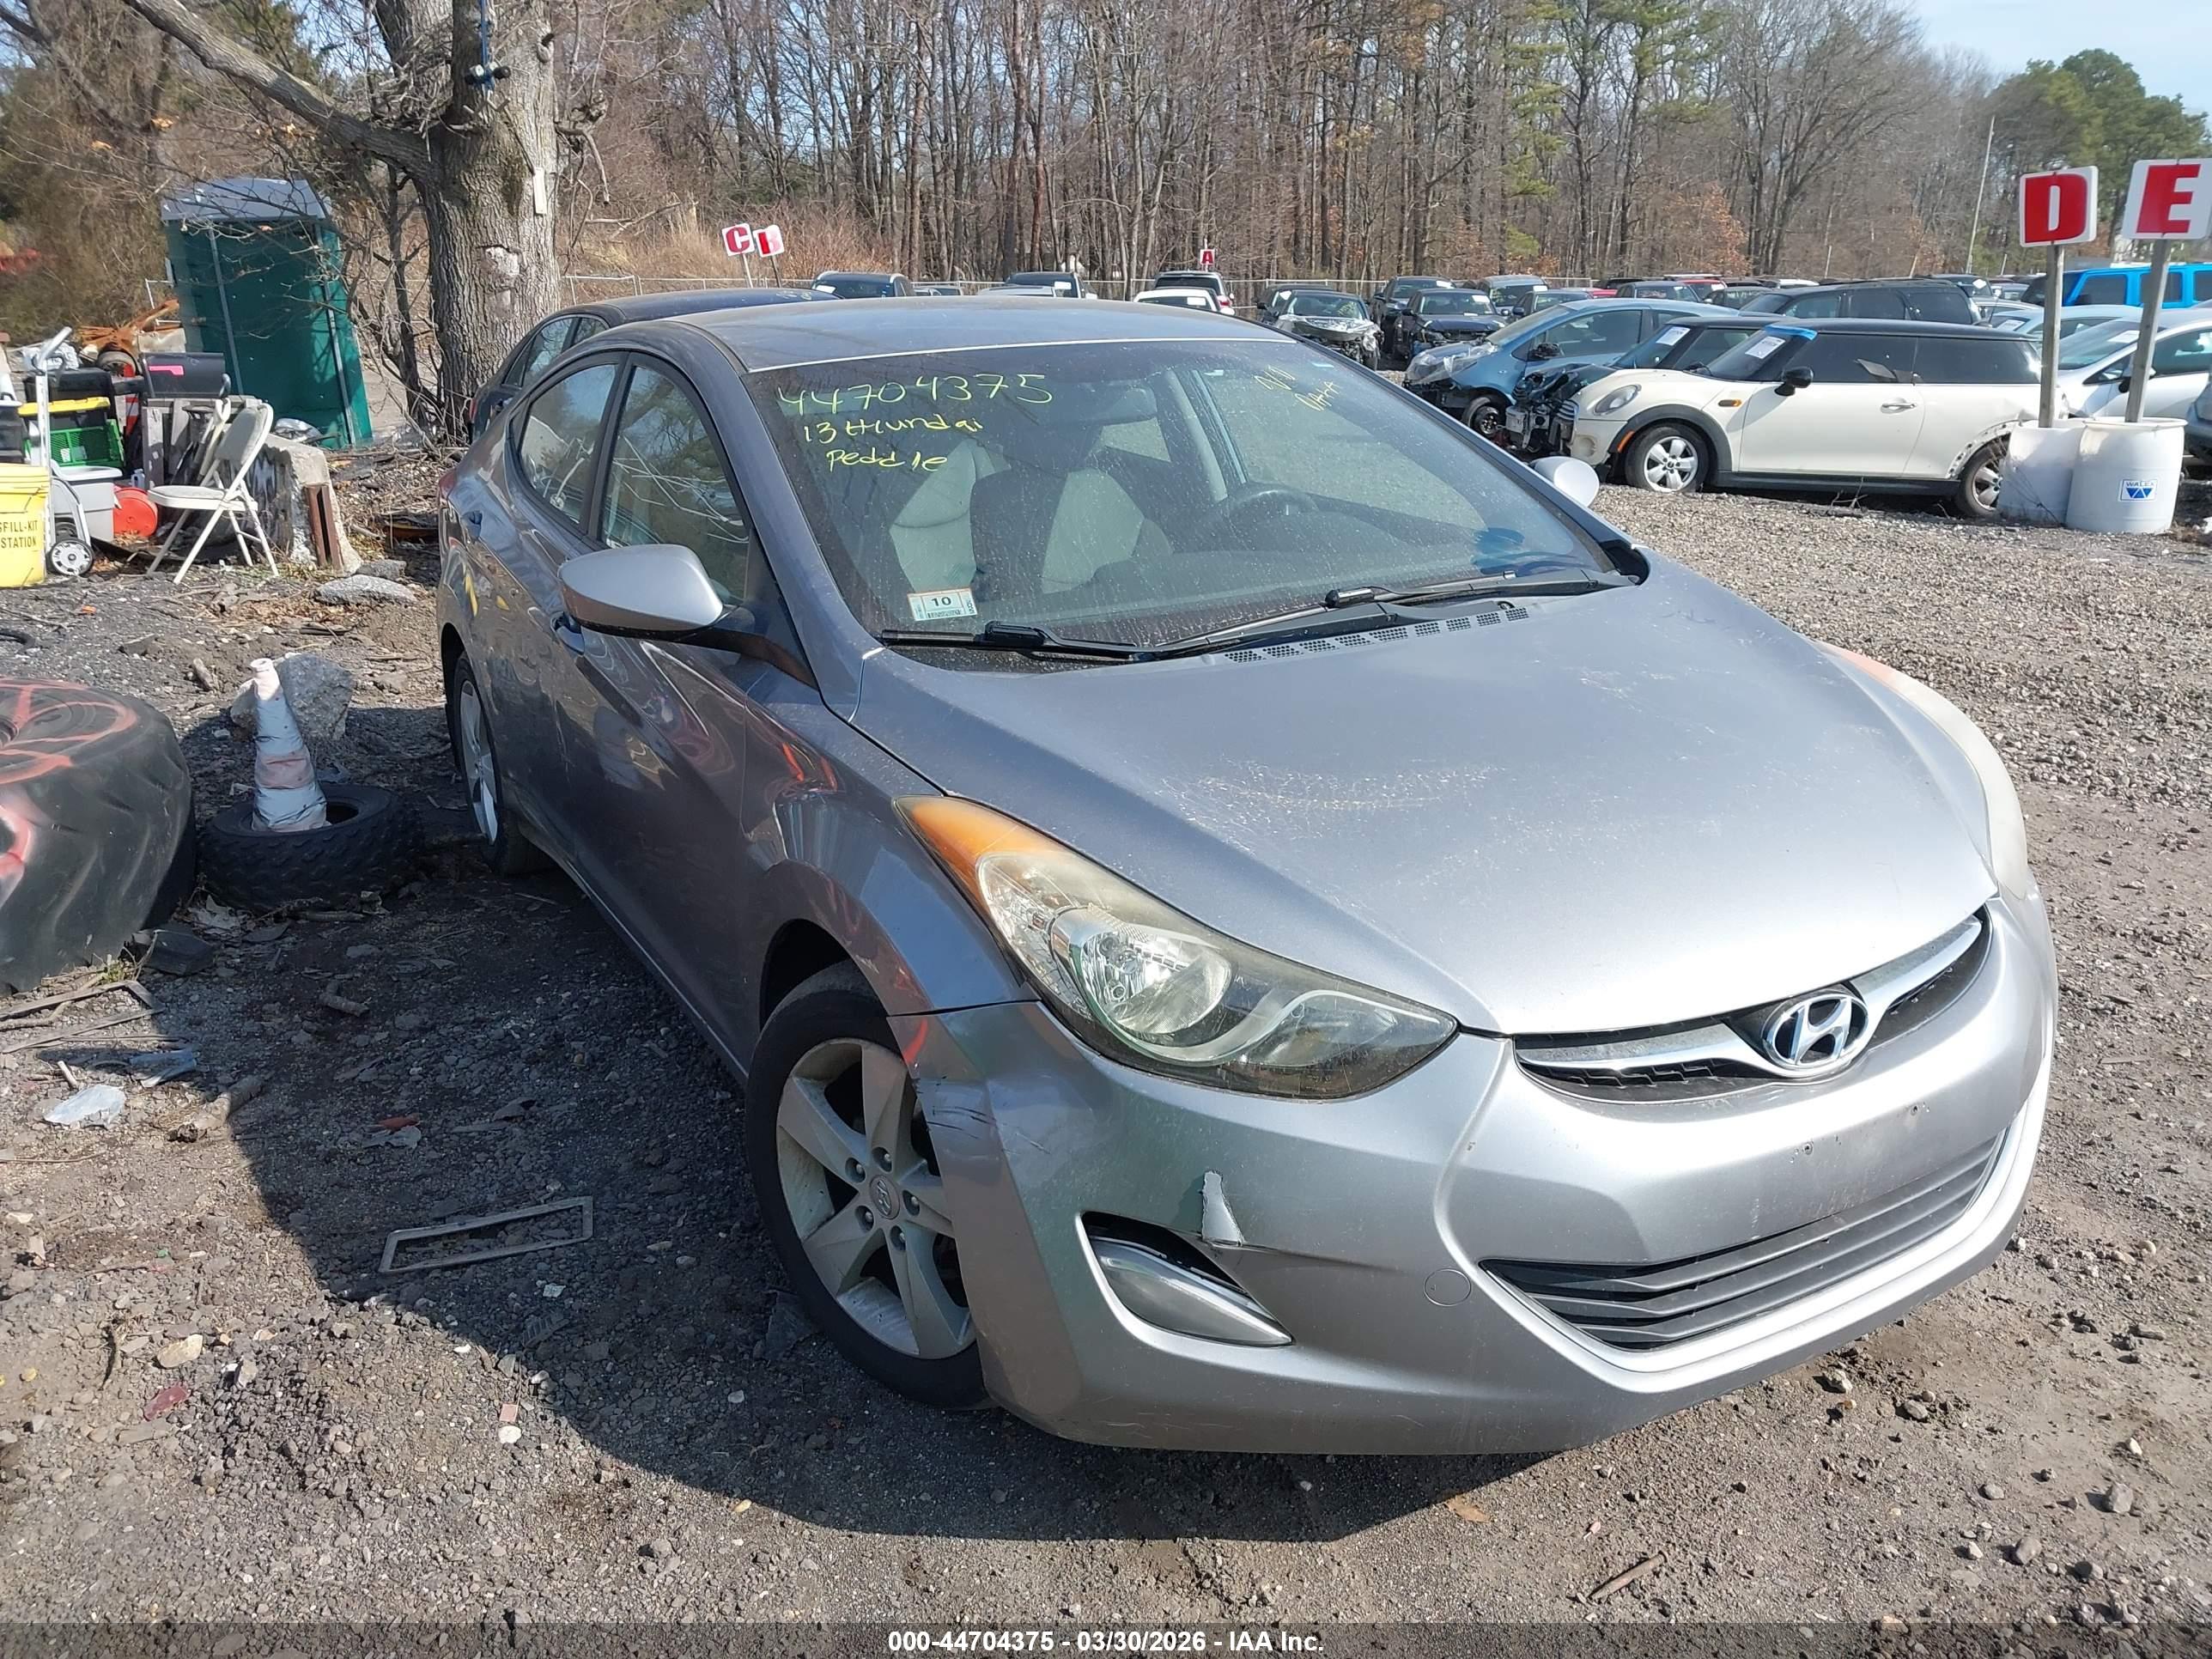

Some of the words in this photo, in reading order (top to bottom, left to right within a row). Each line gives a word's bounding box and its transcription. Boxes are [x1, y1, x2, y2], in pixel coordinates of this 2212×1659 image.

[2024, 173, 2087, 243] D
[2136, 163, 2201, 234] E
[726, 227, 750, 252] C
[1201, 251, 1214, 264] A
[804, 421, 837, 444] 13
[1, 536, 37, 549] STATION
[931, 596, 951, 607] 10
